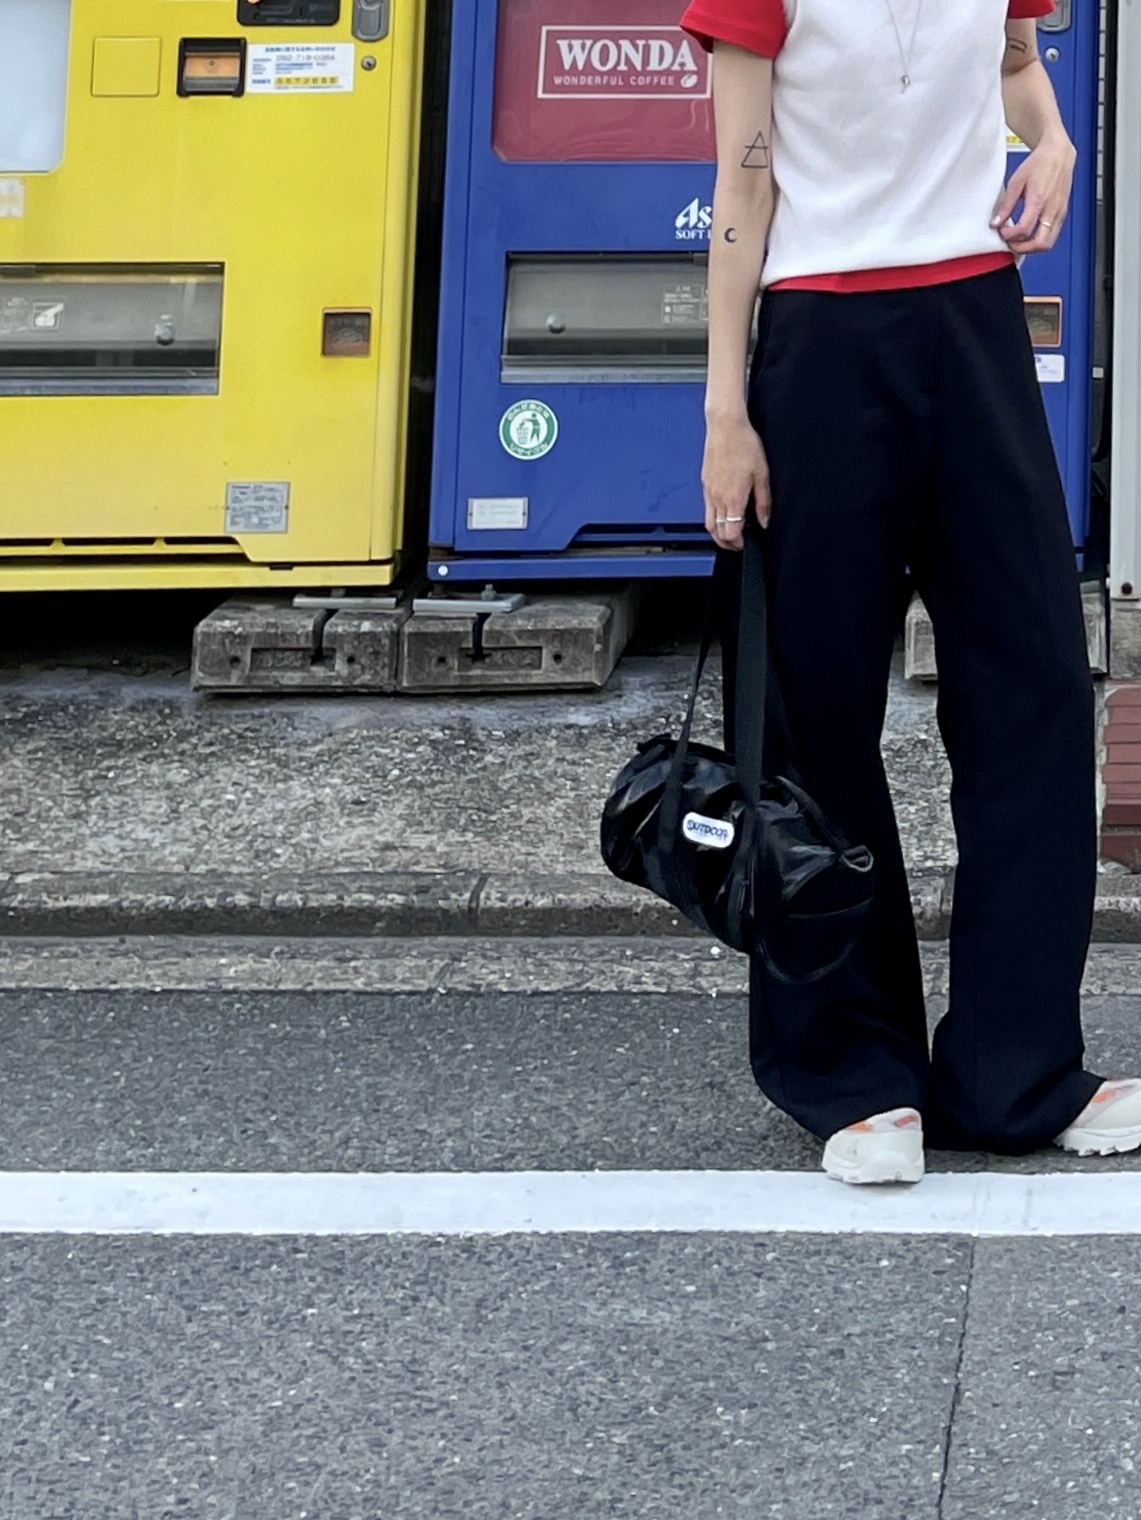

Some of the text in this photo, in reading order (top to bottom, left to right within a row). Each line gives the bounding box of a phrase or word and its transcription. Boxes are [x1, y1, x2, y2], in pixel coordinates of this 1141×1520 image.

[556, 39, 697, 71] WONDA
[553, 75, 675, 86] WONDERFUL COFFEE
[675, 197, 712, 229] As
[675, 229, 705, 240] SOFT
